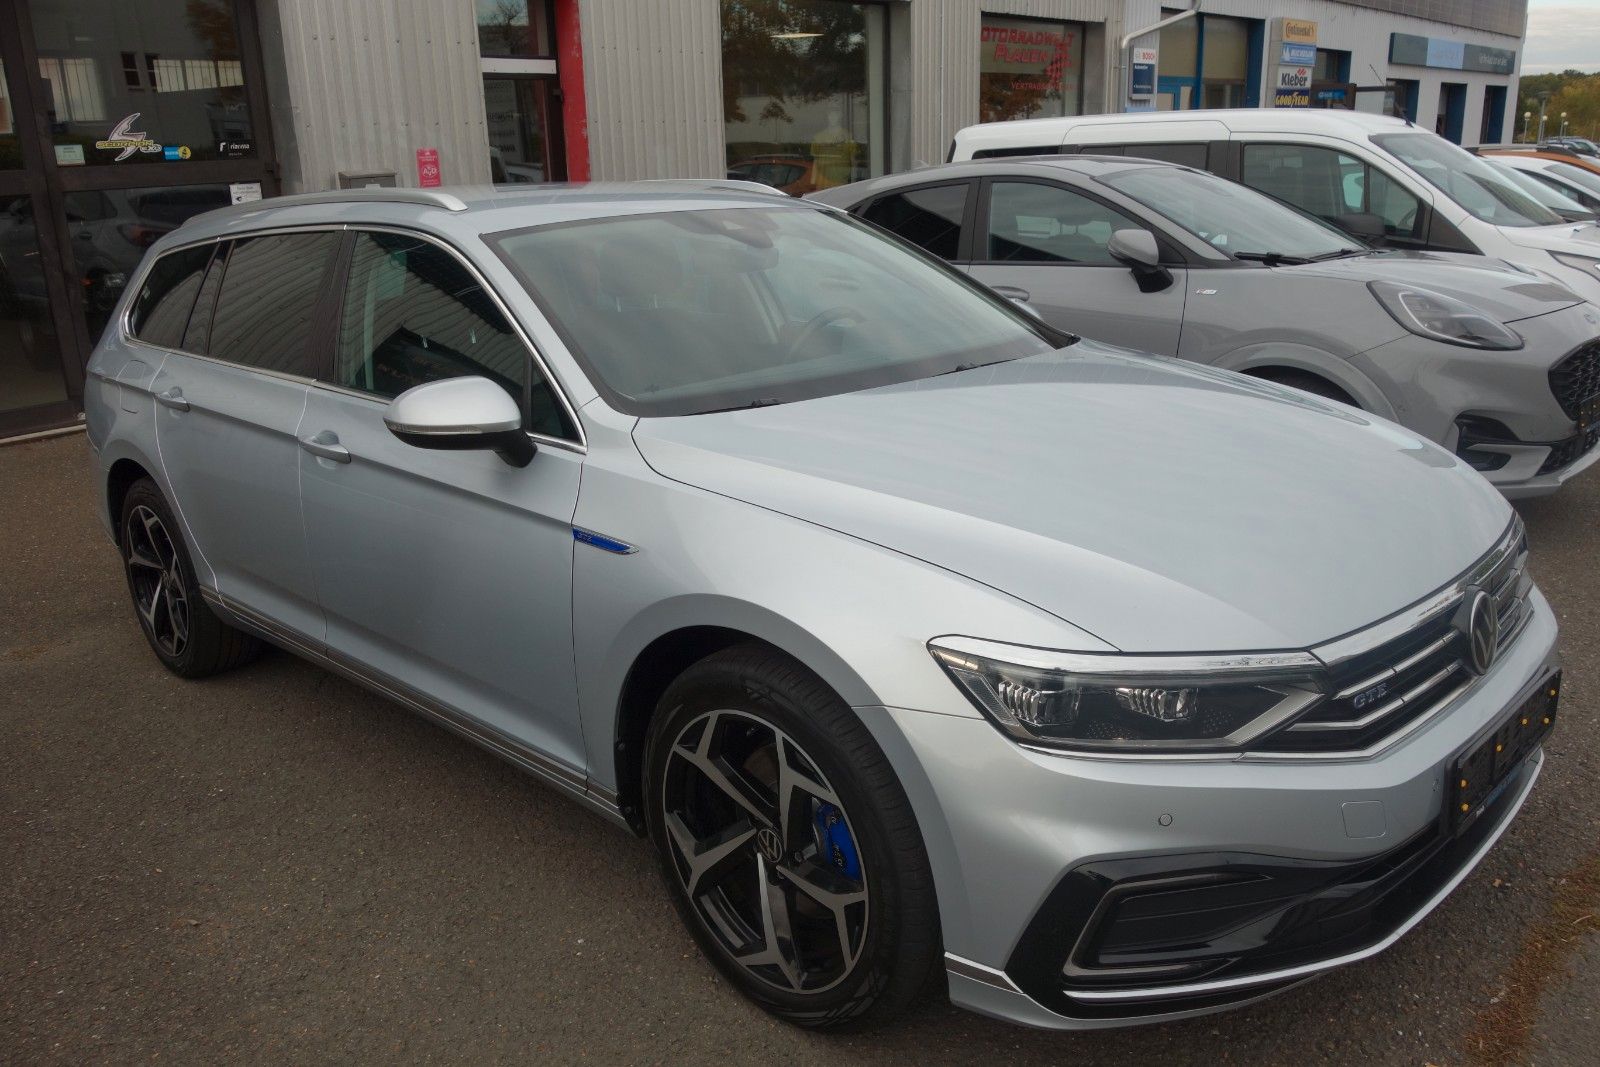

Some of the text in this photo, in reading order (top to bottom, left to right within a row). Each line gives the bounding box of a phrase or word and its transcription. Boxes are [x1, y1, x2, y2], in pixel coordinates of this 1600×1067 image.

[995, 43, 1049, 63] PLAUEN
[1281, 72, 1308, 87] Kleber
[1275, 94, 1309, 106] GOODYEAR
[97, 140, 154, 149] SCORPION
[1354, 682, 1389, 709] GTE
